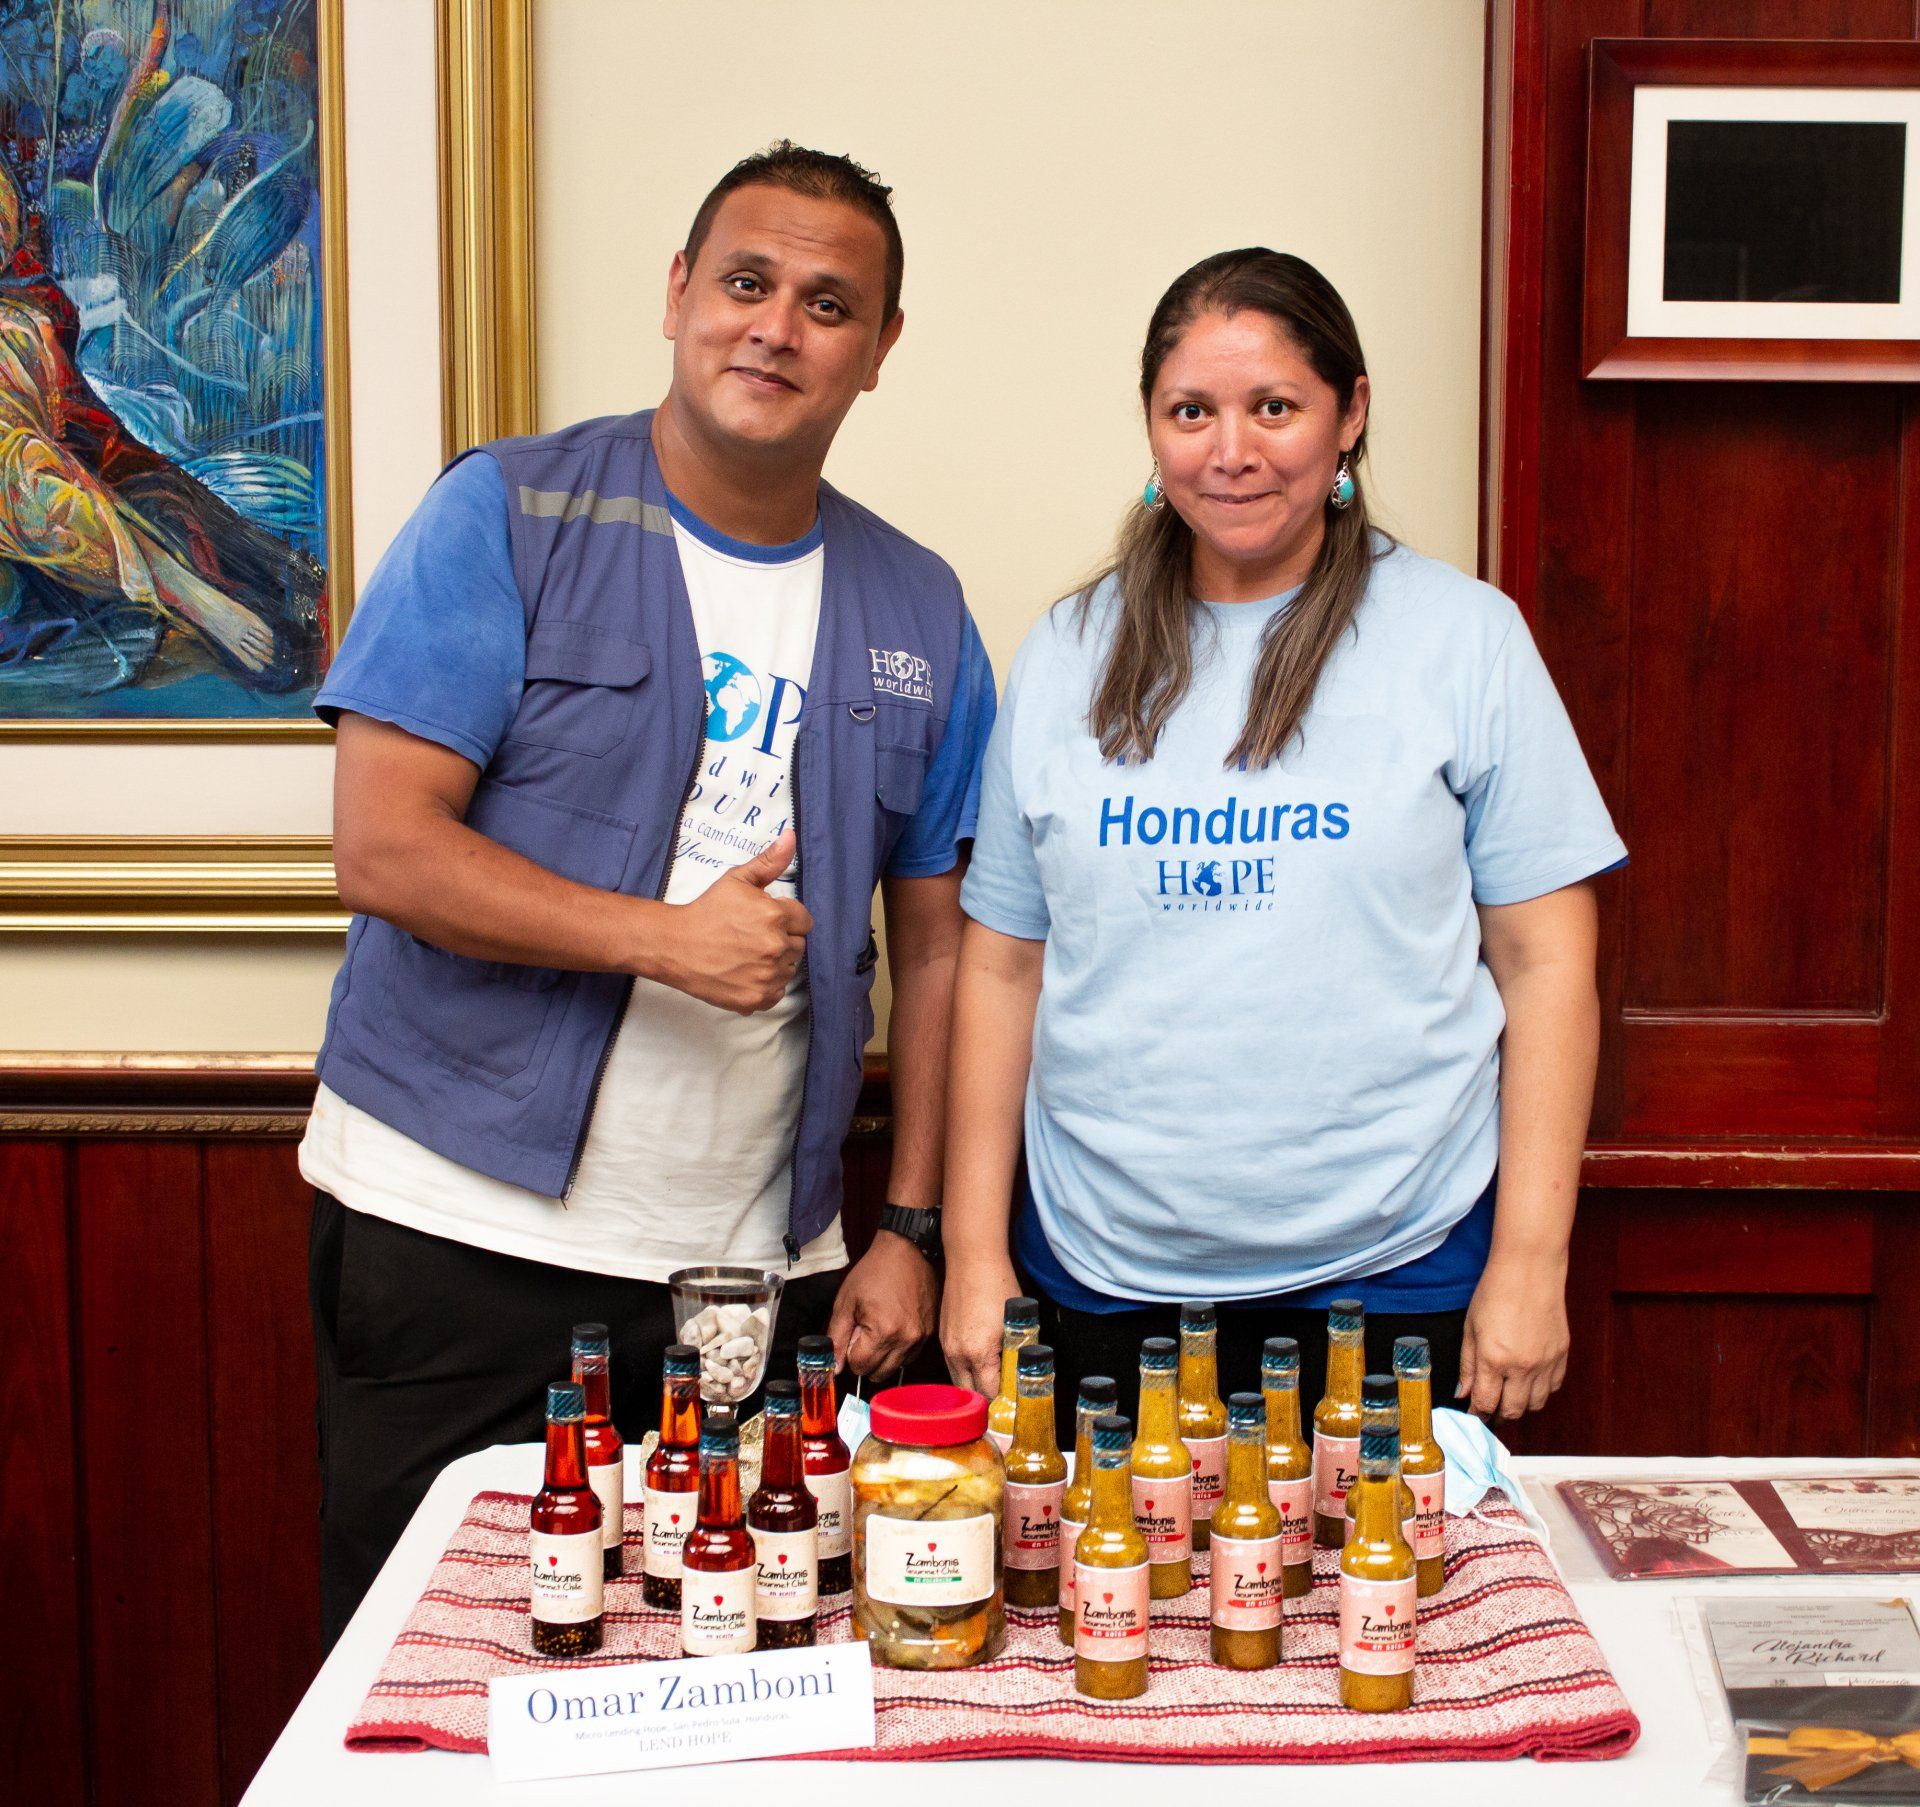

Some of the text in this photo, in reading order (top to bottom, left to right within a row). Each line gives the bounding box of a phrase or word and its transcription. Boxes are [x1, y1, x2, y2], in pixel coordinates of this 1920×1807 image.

[1100, 796, 1350, 846] Honduras
[697, 821, 772, 856] cambiand
[1156, 856, 1276, 897] HOPE
[1163, 899, 1274, 911] worldwide
[1136, 1512, 1175, 1526] ambonis
[906, 1552, 960, 1568] Zambonis
[533, 1563, 582, 1583] Zambonis
[757, 1563, 808, 1581] Zambonis
[906, 1566, 960, 1575] Gourmet Chile
[563, 1582, 583, 1591] Chile
[757, 1578, 808, 1589] Gourmet Chile
[1235, 1590, 1268, 1598] Gourmet
[692, 1605, 746, 1622] Zambonis
[1083, 1601, 1137, 1620] Zambonis
[693, 1620, 746, 1630] Gourmet Chile
[1083, 1617, 1137, 1628] Gourmet Chile
[1361, 1630, 1397, 1640] Gourmet
[1785, 1649, 1887, 1667] Richard
[527, 1661, 836, 1724] Omar Zamboni
[576, 1731, 603, 1741] Micro
[605, 1727, 640, 1738] Lending
[673, 1721, 689, 1731] San
[692, 1718, 719, 1729] Pedro
[639, 1730, 733, 1753] LEND HOPE
